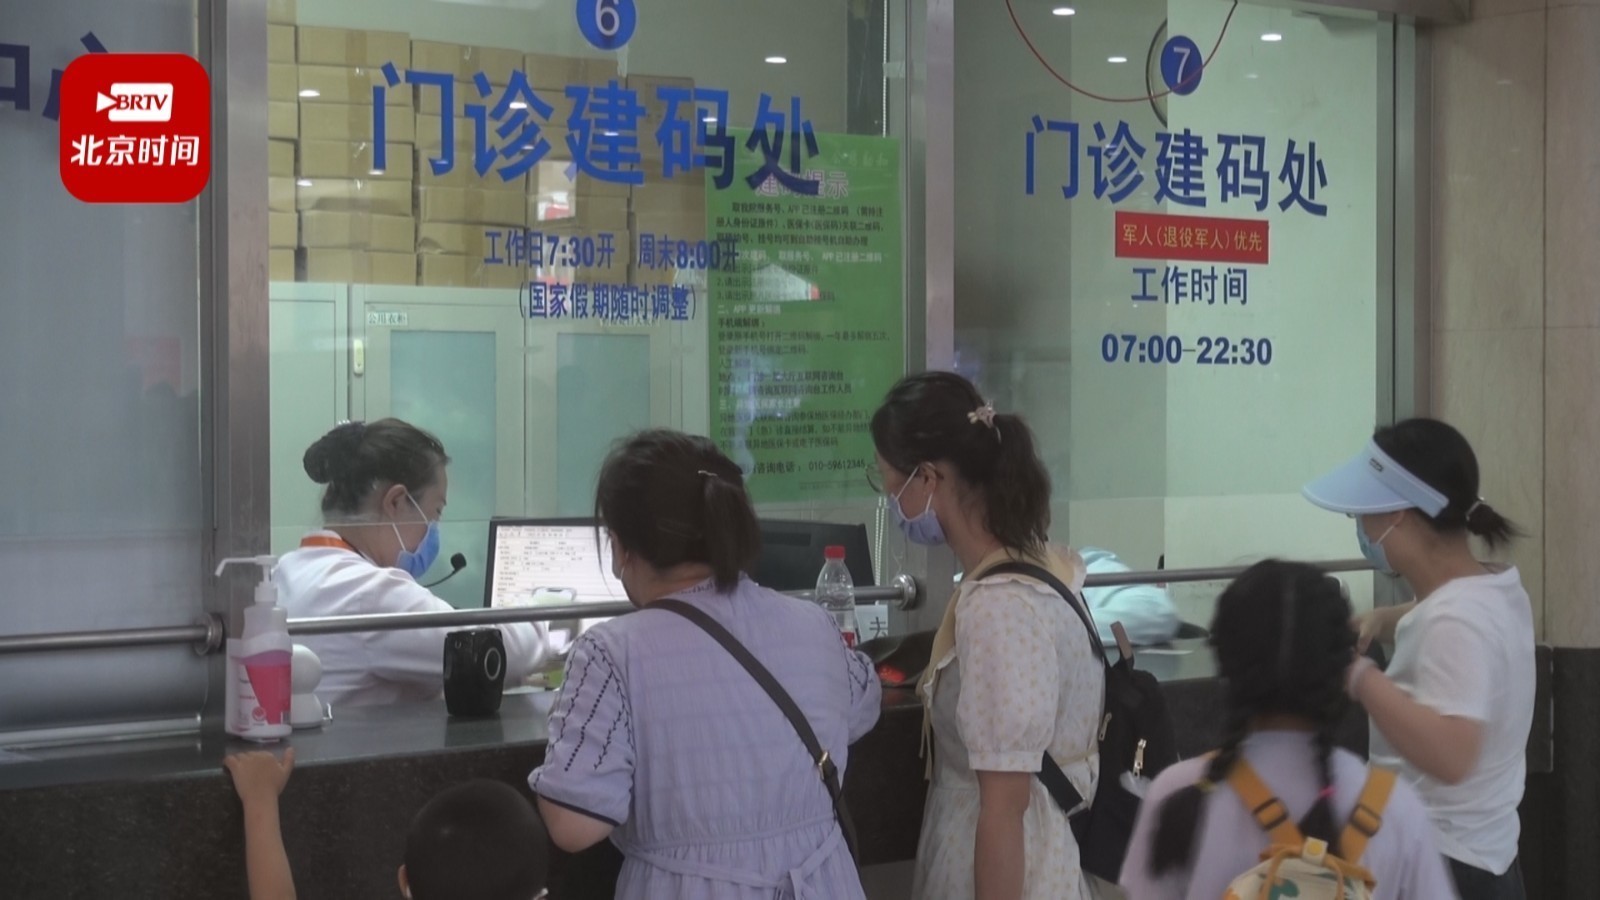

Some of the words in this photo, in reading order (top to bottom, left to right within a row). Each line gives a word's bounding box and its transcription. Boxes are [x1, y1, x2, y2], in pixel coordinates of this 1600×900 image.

[595, 0, 620, 36] 6
[1173, 46, 1191, 84] 7
[372, 61, 820, 195] 门诊建码处
[1025, 115, 1328, 216] 门诊建码处
[484, 230, 615, 269] 工作日7:30开
[638, 233, 740, 272] 周末8:00开
[1122, 223, 1263, 252] 军人（退役军人）优先
[519, 281, 697, 321] （国家假期随时调整）
[1131, 266, 1248, 305] 工作时间
[808, 460, 866, 472] 010-59612345
